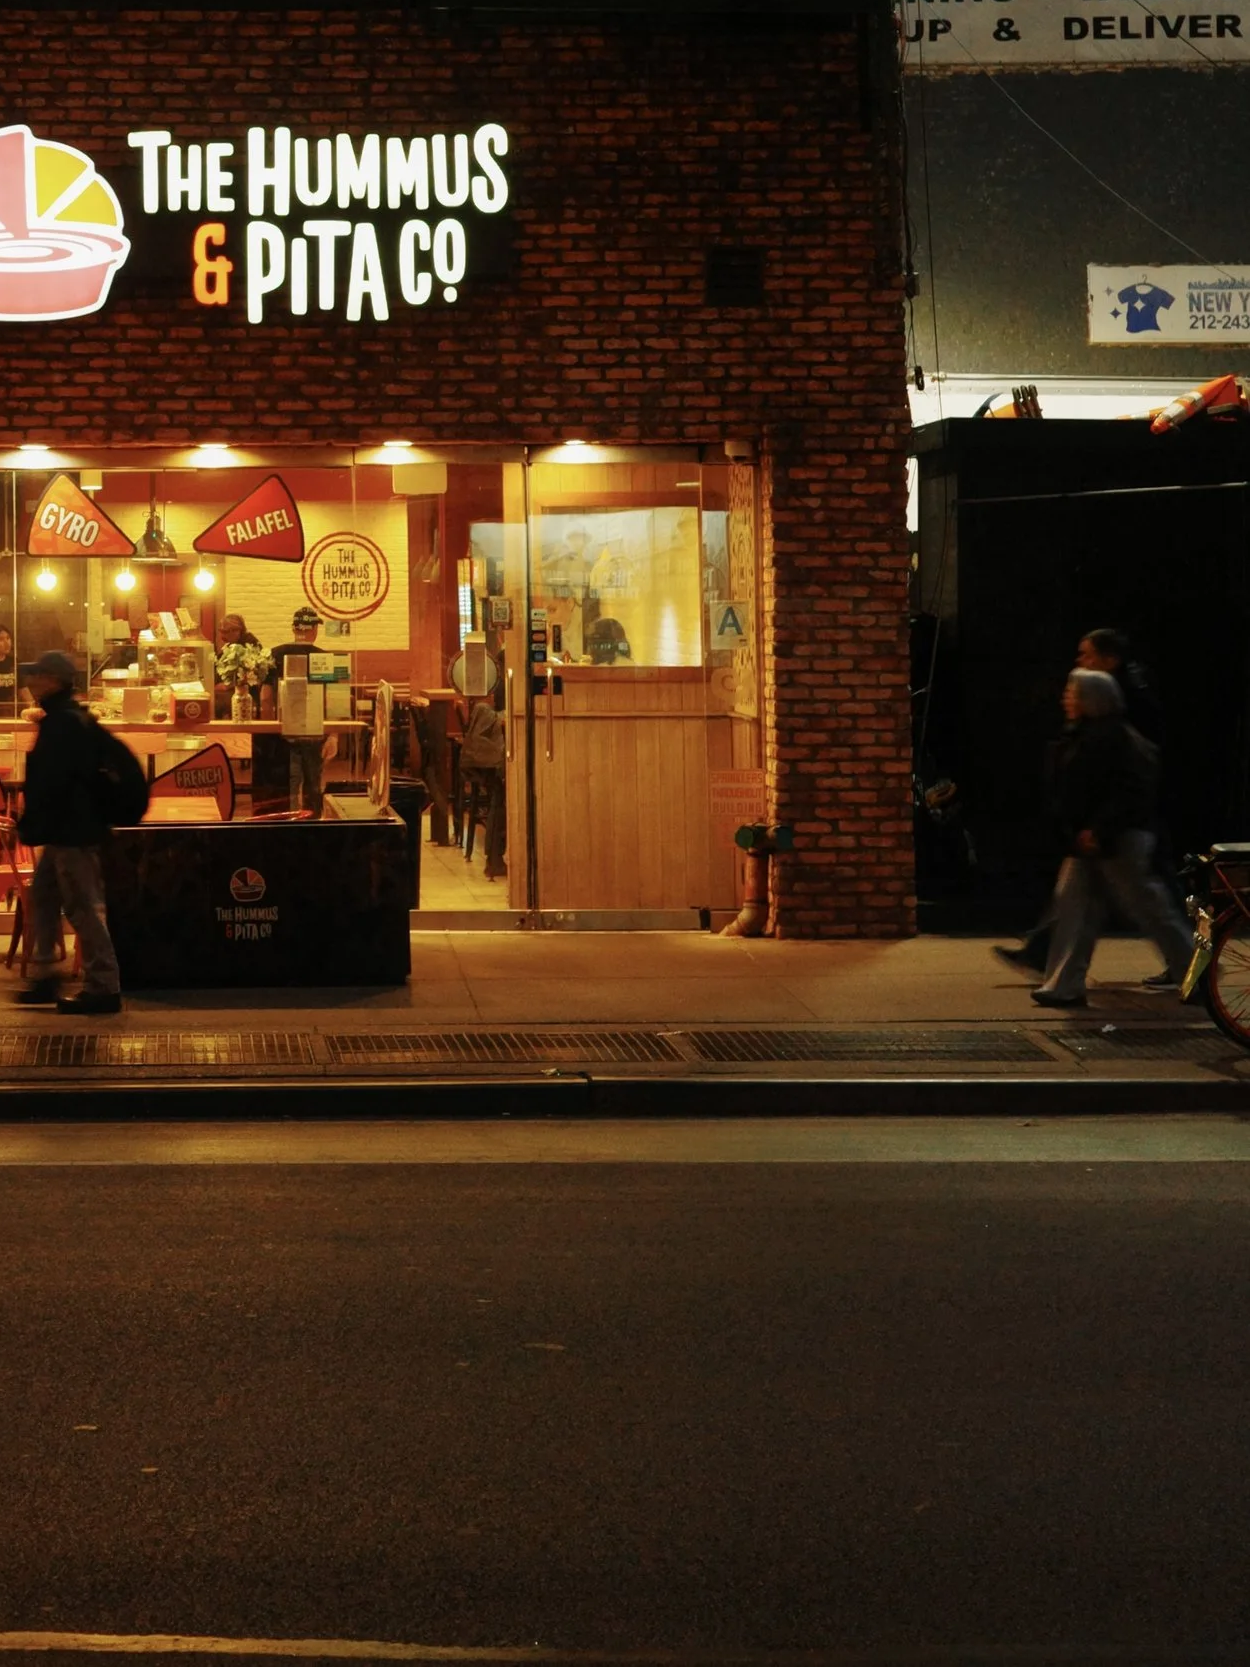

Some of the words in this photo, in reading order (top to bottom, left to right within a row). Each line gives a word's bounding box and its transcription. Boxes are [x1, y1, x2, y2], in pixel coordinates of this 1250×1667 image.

[993, 17, 1021, 42] &
[1063, 14, 1243, 42] DELIVER
[127, 130, 236, 214] THE
[247, 122, 509, 217] HUMMUS
[192, 222, 234, 306] &
[246, 219, 390, 325] PITA
[1188, 291, 1233, 313] NEW
[39, 502, 101, 549] GYRO
[225, 508, 294, 547] FALAFEL
[323, 562, 370, 580] HUMMUS
[717, 605, 744, 636] A
[175, 767, 223, 787] FRENCH
[712, 801, 763, 814] BUILDING
[234, 905, 279, 923] HUMMUS
